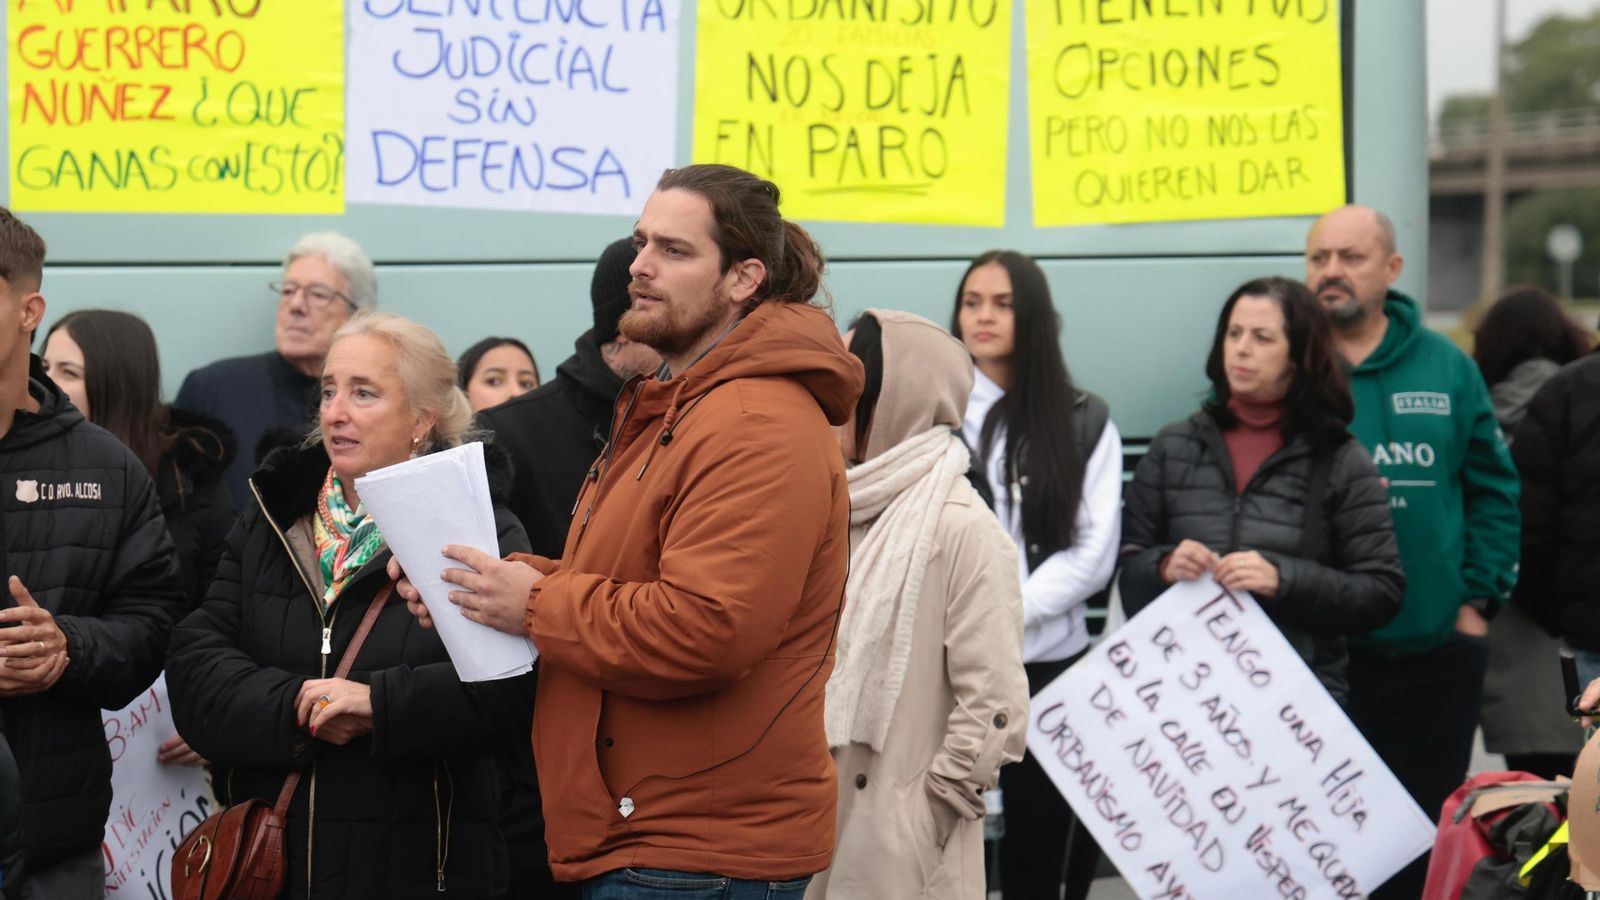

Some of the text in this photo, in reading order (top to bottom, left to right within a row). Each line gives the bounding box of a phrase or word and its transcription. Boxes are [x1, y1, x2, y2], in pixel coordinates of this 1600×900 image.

[18, 24, 245, 71] GUERRERO
[1053, 43, 1280, 99] OPCIONES
[21, 76, 317, 127] NUÑEZ ¿QUE
[747, 52, 971, 118] NOS DEJA
[715, 119, 947, 184] EN PARO
[1046, 103, 1319, 157] PERO NO NOS LAS
[18, 144, 178, 191] GANAS
[372, 130, 630, 198] DEFENSA
[1074, 157, 1309, 208] QUIEREN DAR
[1399, 397, 1446, 408] ITALIA
[1373, 442, 1435, 467] ANO
[75, 482, 101, 500] ALCOSA
[1195, 579, 1271, 688] TENGO
[1279, 704, 1324, 763] UNA
[1089, 684, 1127, 728] DE
[1107, 640, 1138, 679] EN
[1211, 785, 1247, 825] EN
[1152, 626, 1182, 662] DE
[1179, 662, 1211, 691] 3
[1245, 765, 1282, 790] Y
[1278, 797, 1320, 841] ME
